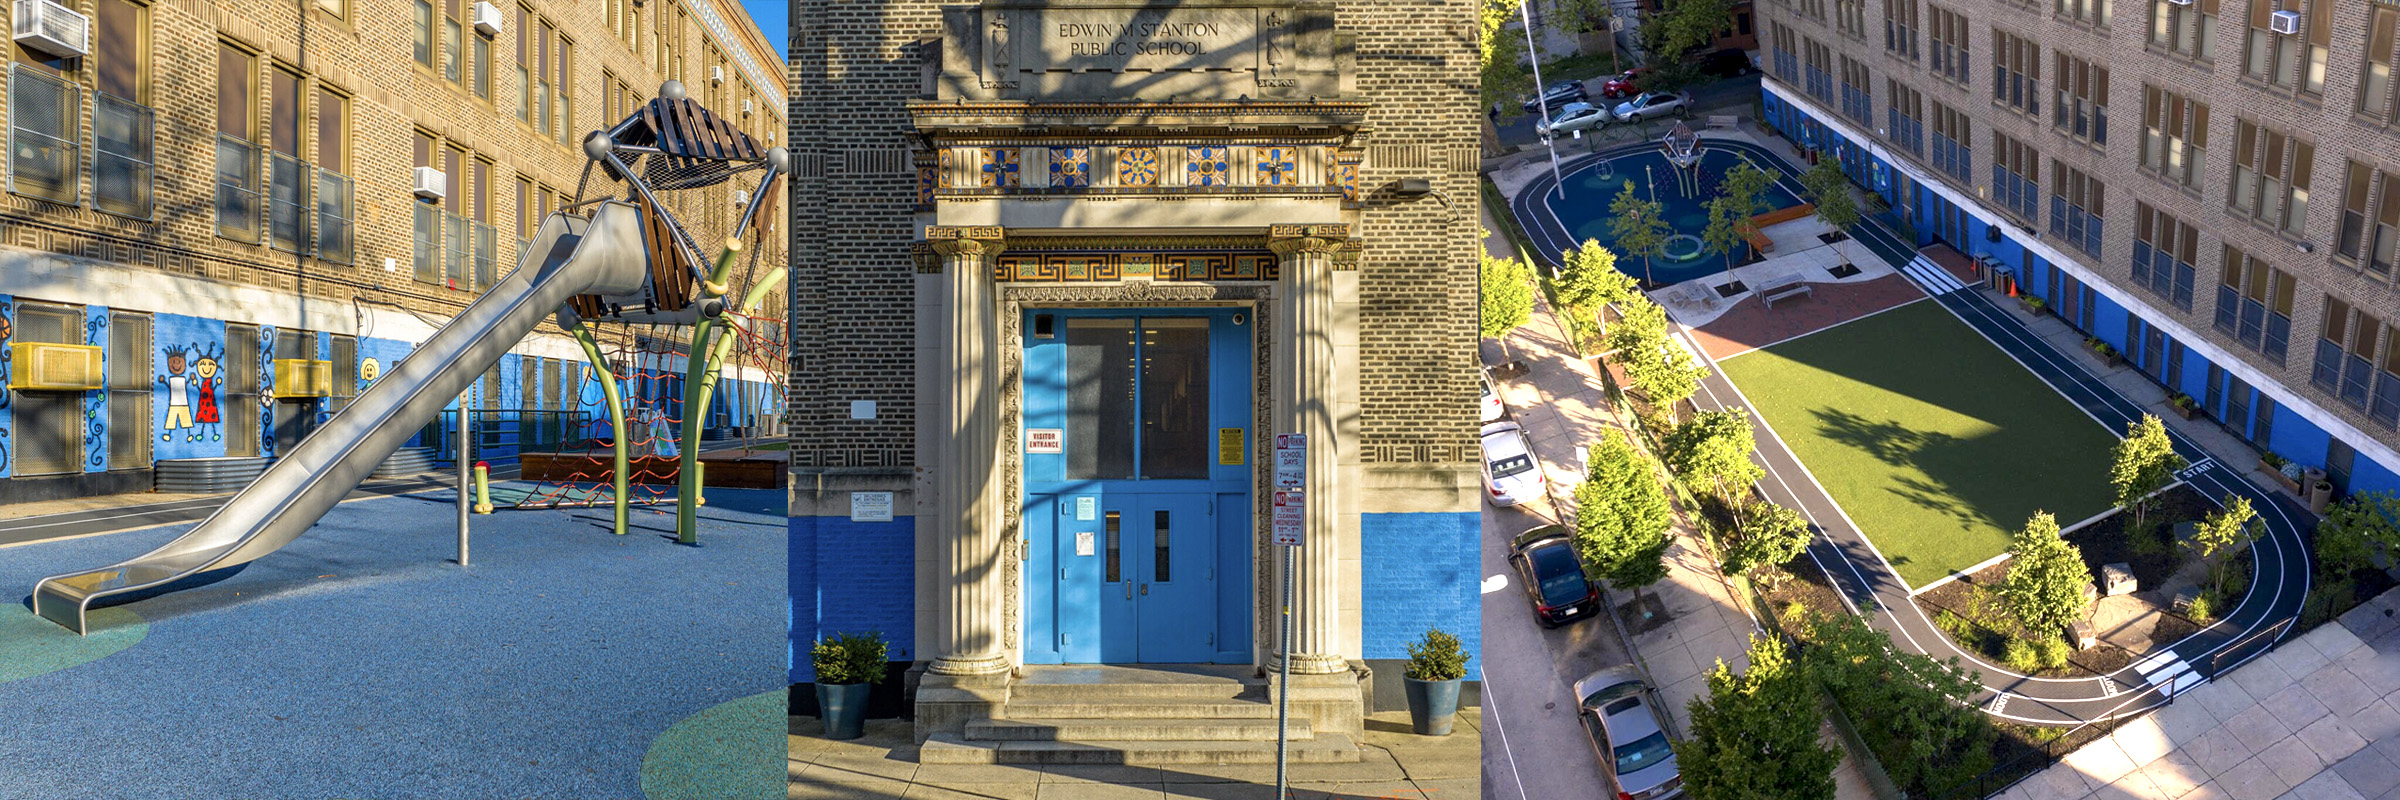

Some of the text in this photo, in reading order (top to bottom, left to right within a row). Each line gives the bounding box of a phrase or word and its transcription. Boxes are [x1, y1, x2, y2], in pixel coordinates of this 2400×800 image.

[1059, 22, 1219, 38] EDWIN M STANTON
[1071, 41, 1207, 56] PUBLIC SCHOOL
[1278, 436, 1305, 449] NO PARKING
[2183, 461, 2215, 478] START
[1276, 493, 1285, 505] NO
